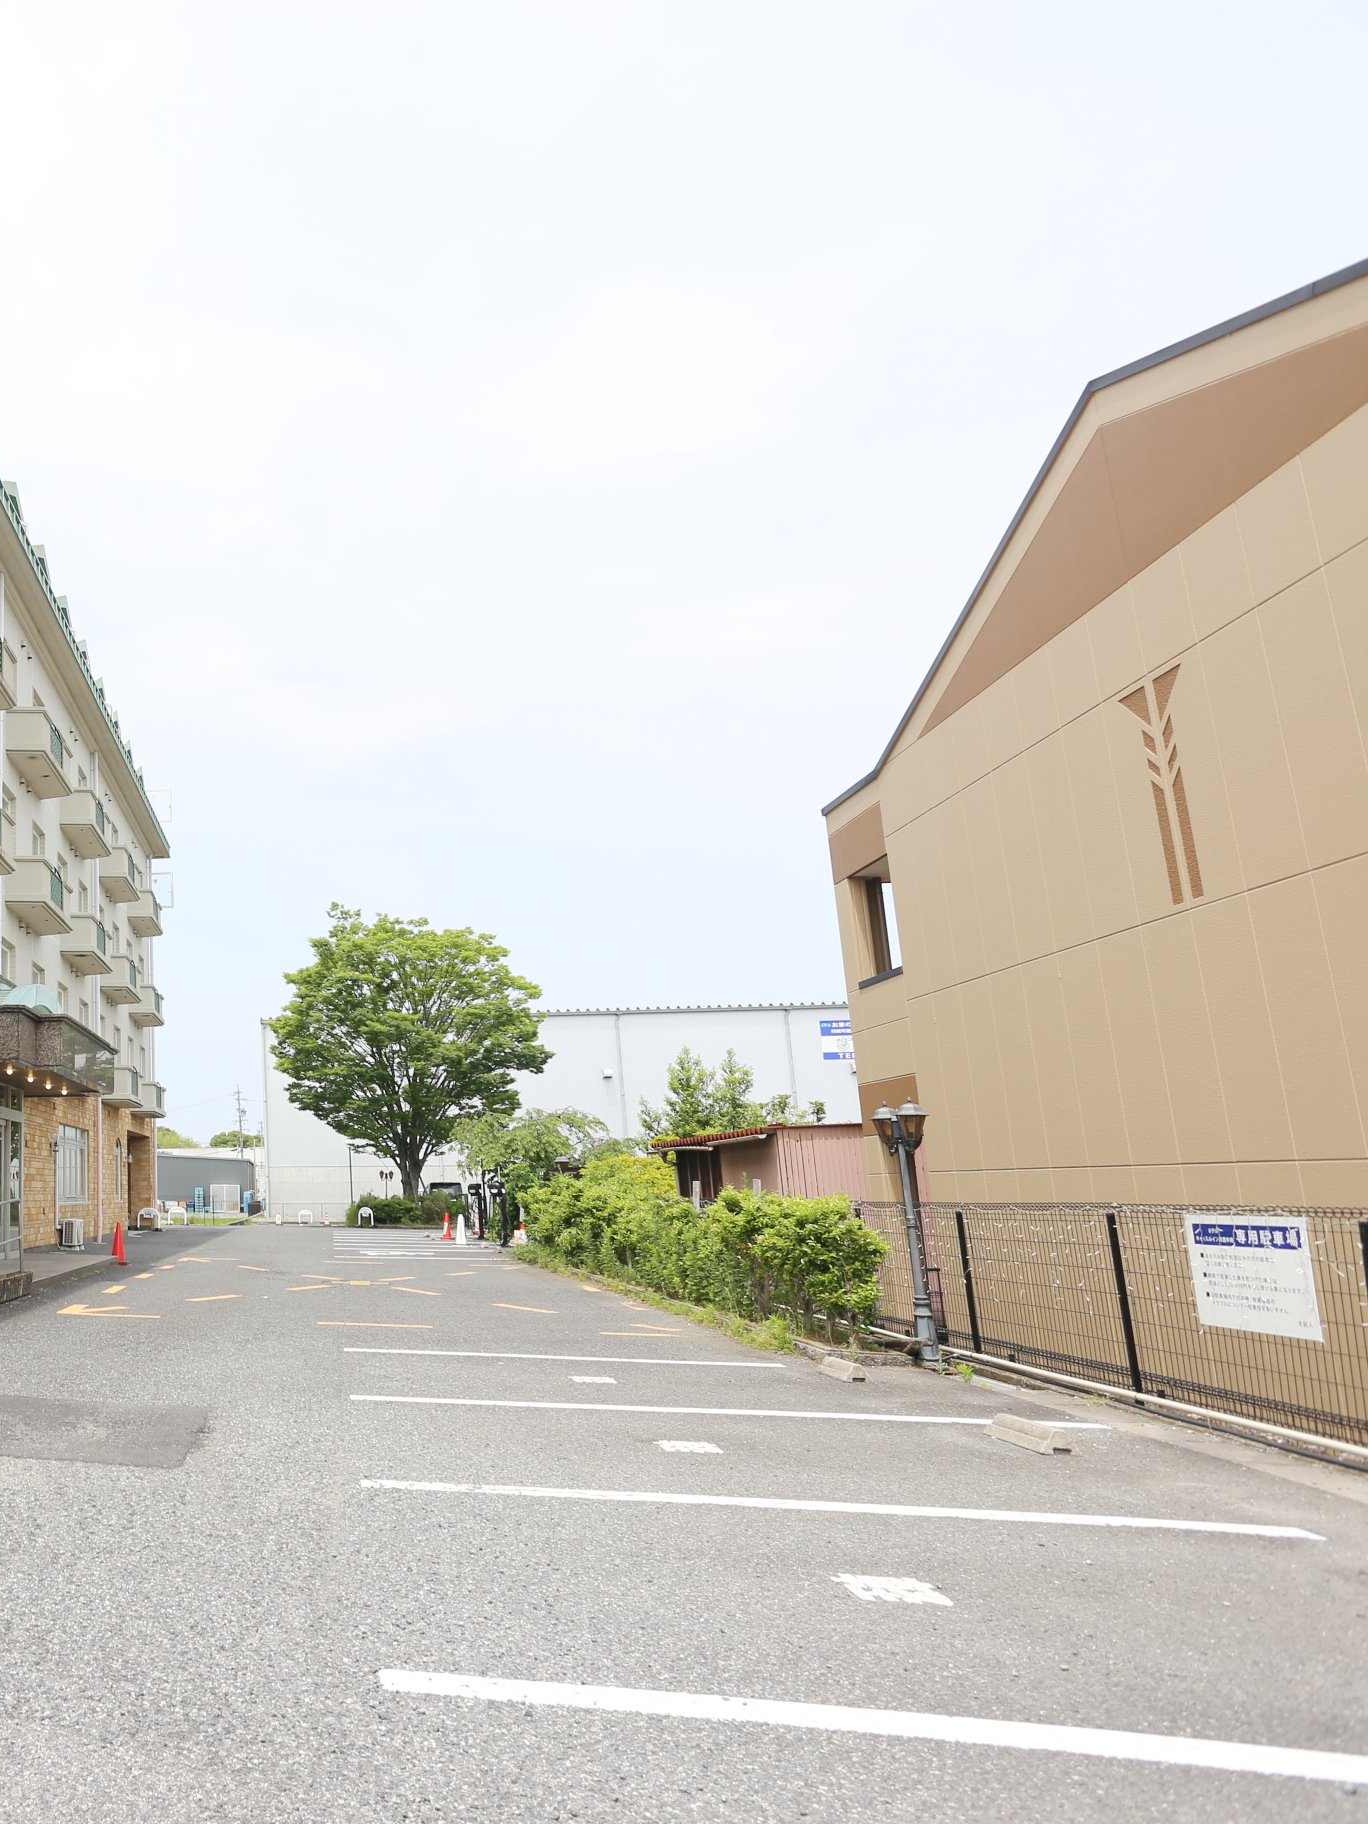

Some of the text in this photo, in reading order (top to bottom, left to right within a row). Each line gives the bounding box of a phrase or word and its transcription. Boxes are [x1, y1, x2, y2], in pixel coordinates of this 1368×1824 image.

[1235, 1228, 1298, 1247] 専用駐車場
